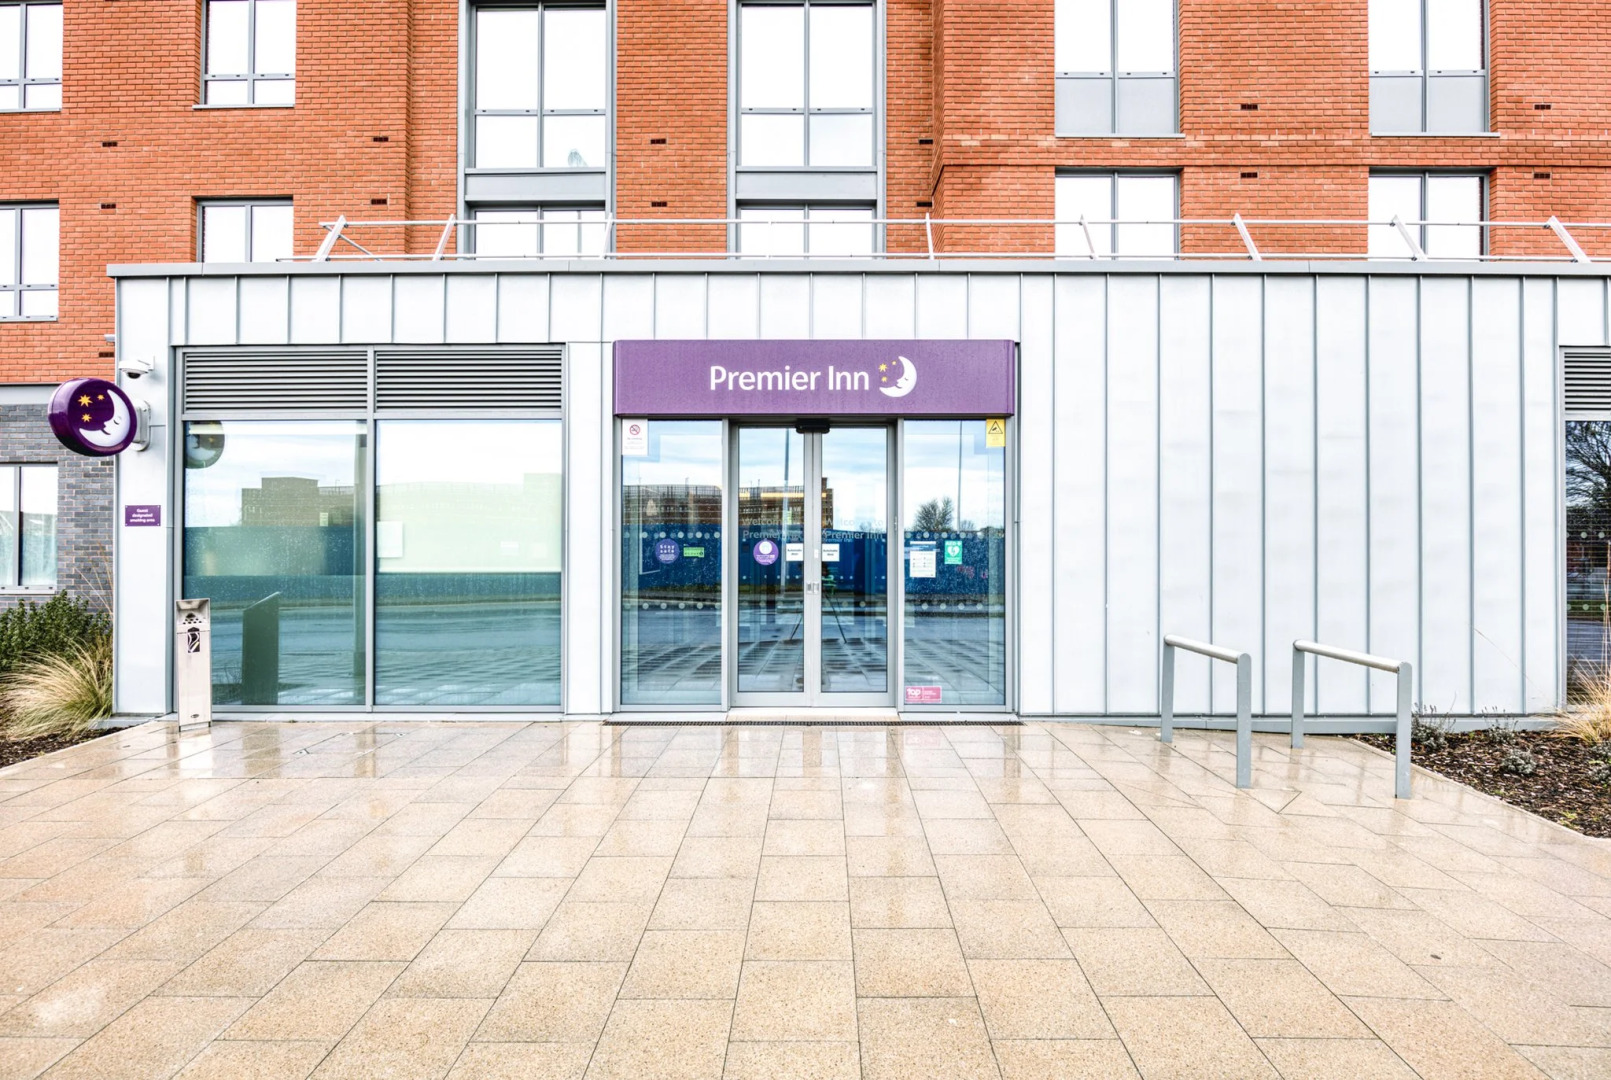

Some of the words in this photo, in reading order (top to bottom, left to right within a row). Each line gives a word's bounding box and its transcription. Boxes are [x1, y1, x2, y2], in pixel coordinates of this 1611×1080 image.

[710, 365, 821, 391] Premier
[828, 365, 870, 391] Inn
[825, 530, 865, 540] Premier
